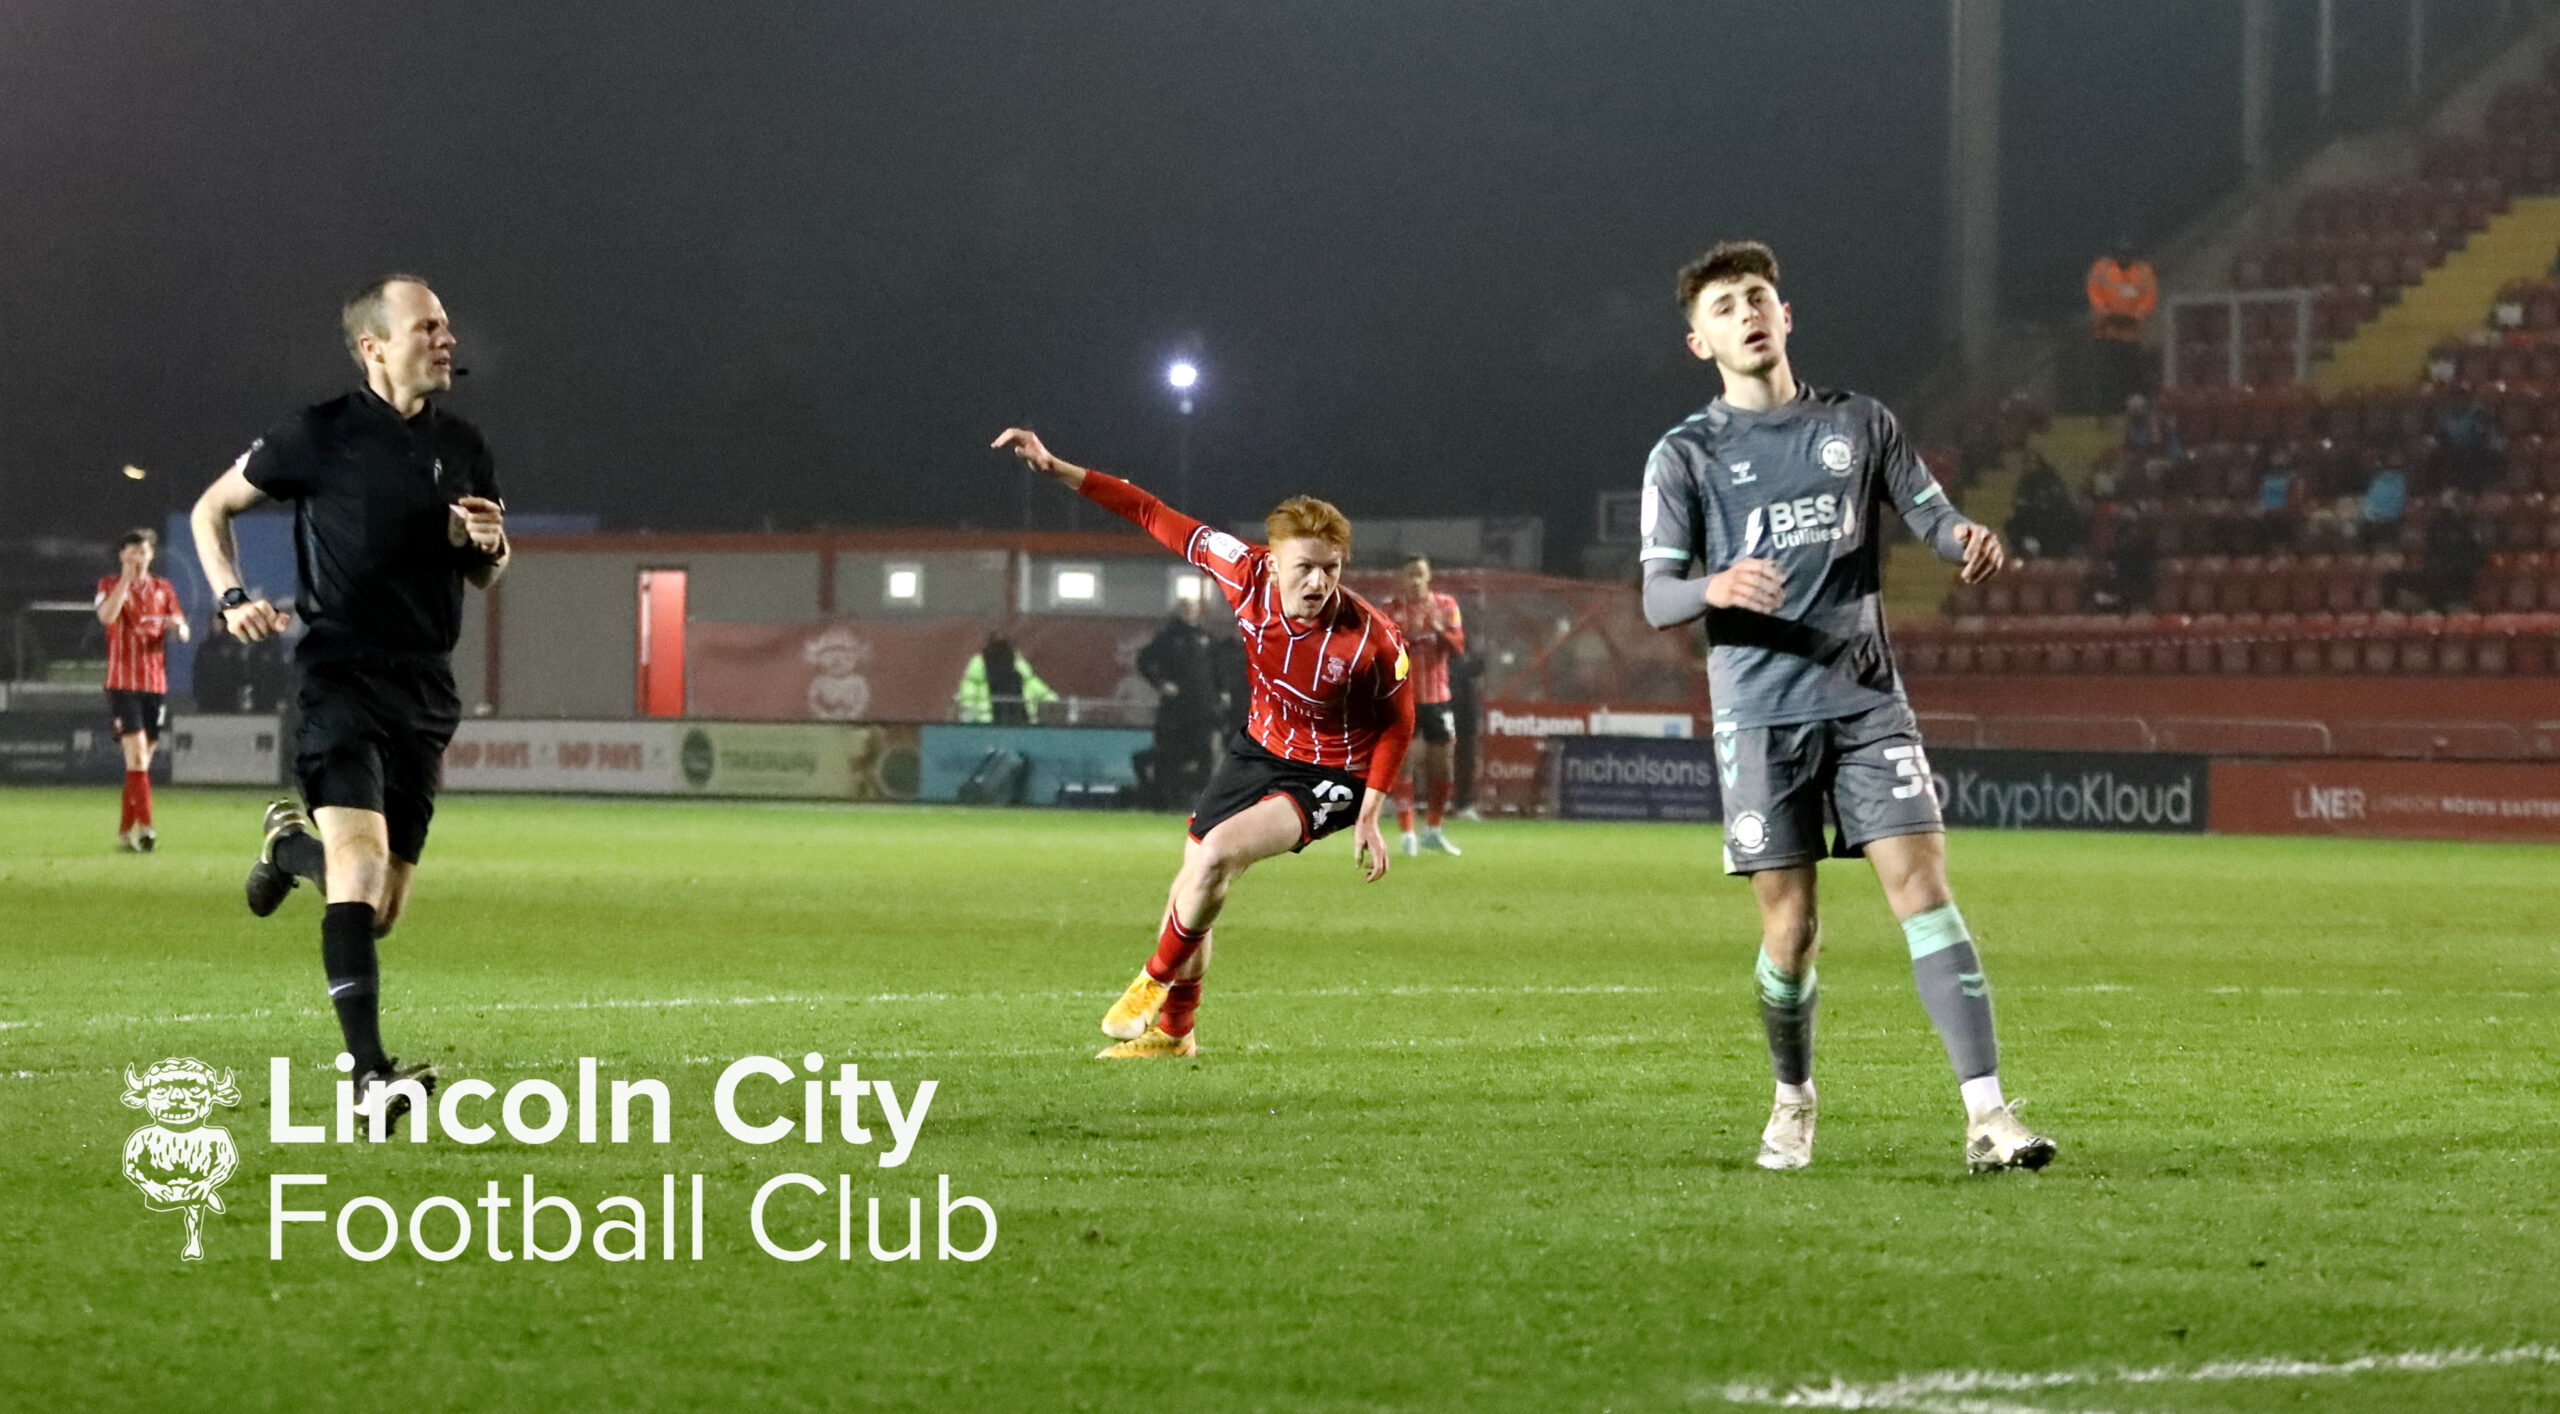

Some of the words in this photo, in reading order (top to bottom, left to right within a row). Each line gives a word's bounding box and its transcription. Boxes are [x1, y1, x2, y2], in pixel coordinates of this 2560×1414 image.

[1768, 494, 1838, 533] BES
[1771, 526, 1842, 550] Utilities
[1564, 753, 1712, 787] nicholsons
[1956, 770, 2192, 828] KryptoKloud
[2293, 785, 2367, 820] LNER
